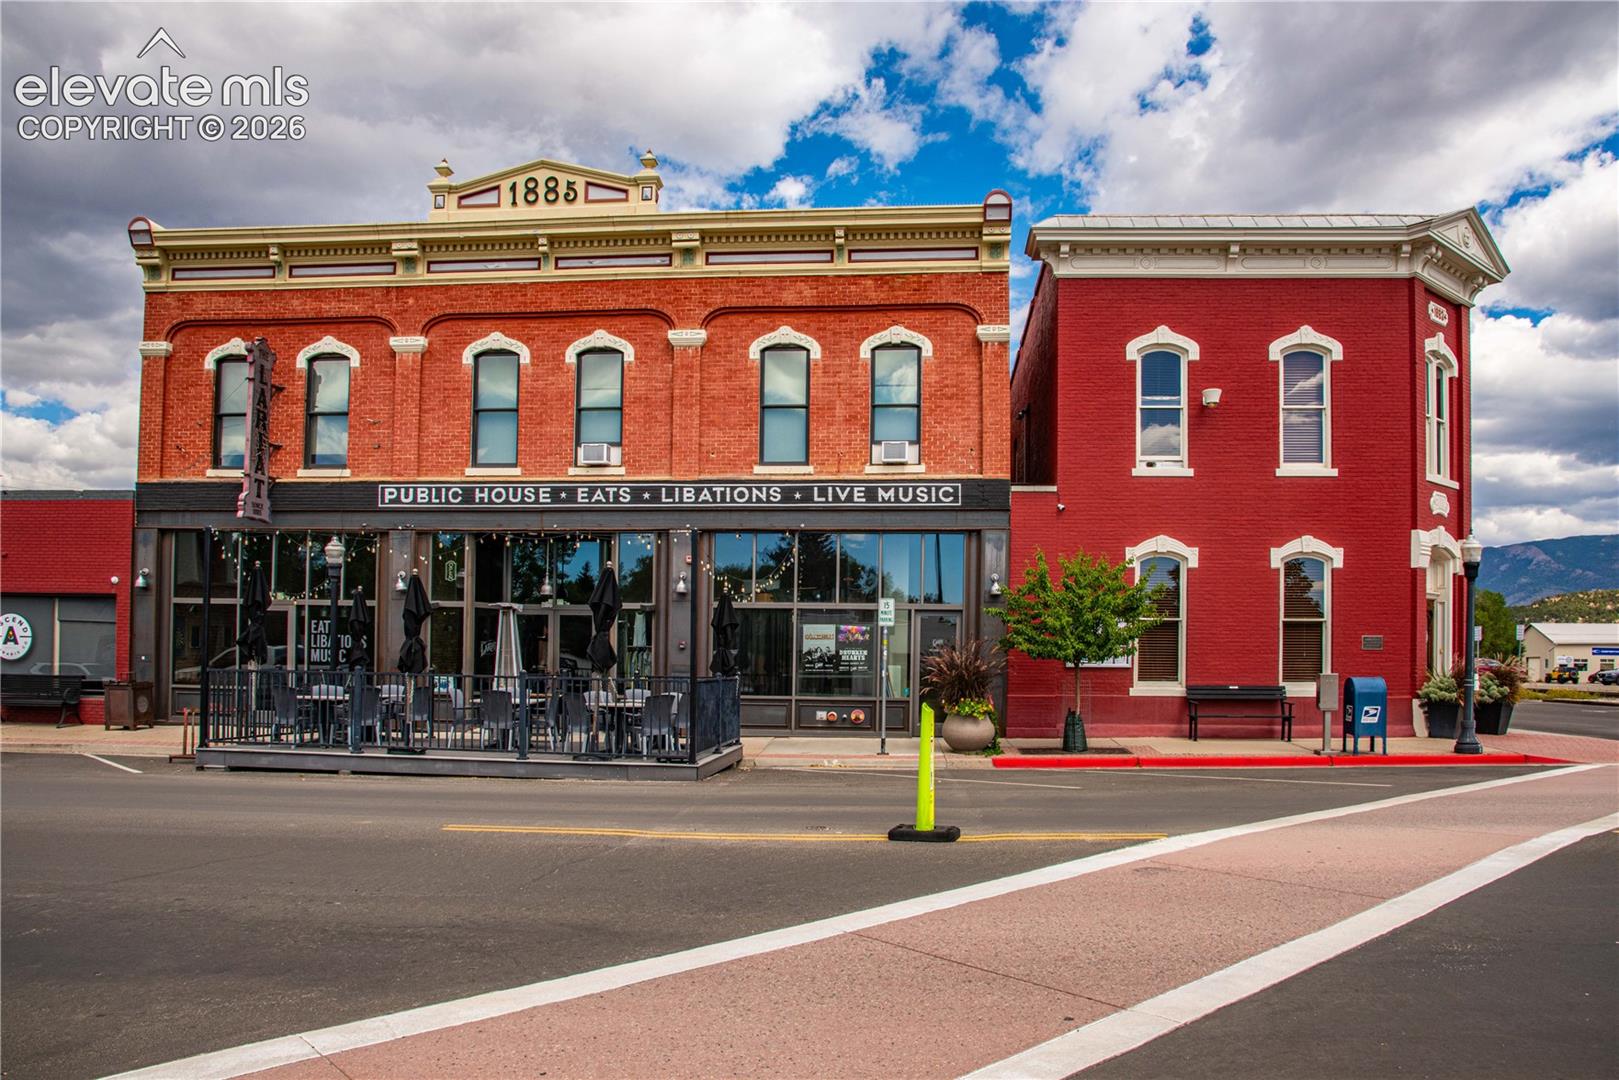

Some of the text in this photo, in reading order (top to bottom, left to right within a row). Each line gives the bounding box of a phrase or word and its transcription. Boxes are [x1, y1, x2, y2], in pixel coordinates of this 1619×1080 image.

[508, 175, 578, 207] 1885
[384, 486, 955, 504] PUBLIC HOUSE EATS LIBATIONS LIVE MUSIC
